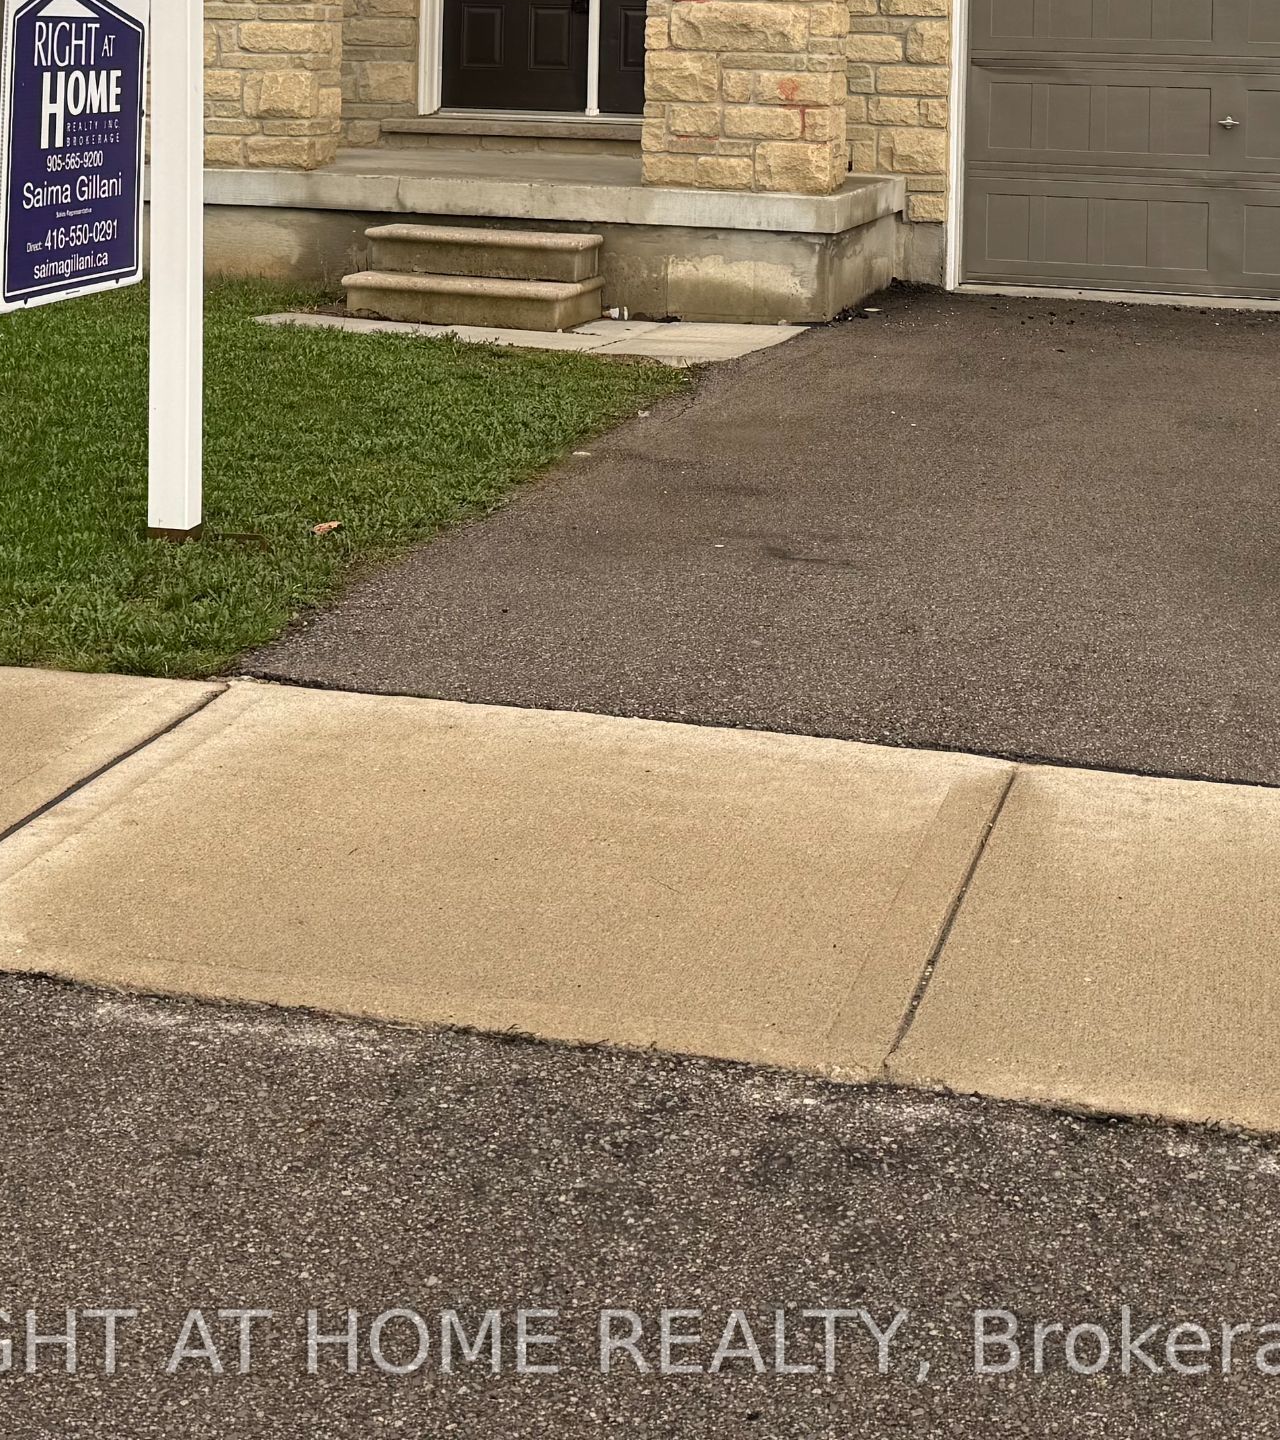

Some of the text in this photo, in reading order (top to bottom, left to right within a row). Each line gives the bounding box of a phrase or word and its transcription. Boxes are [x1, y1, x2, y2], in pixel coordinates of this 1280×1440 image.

[34, 21, 116, 67] RIGHT AT
[41, 70, 121, 149] HOME
[66, 121, 98, 132] REALTY
[66, 133, 120, 147] BROKERAGE
[46, 150, 104, 172] 905-565-9200
[22, 171, 122, 209] Saima Gillani
[44, 219, 118, 251] 416-550-0291
[33, 251, 109, 279] saimagillani.ca
